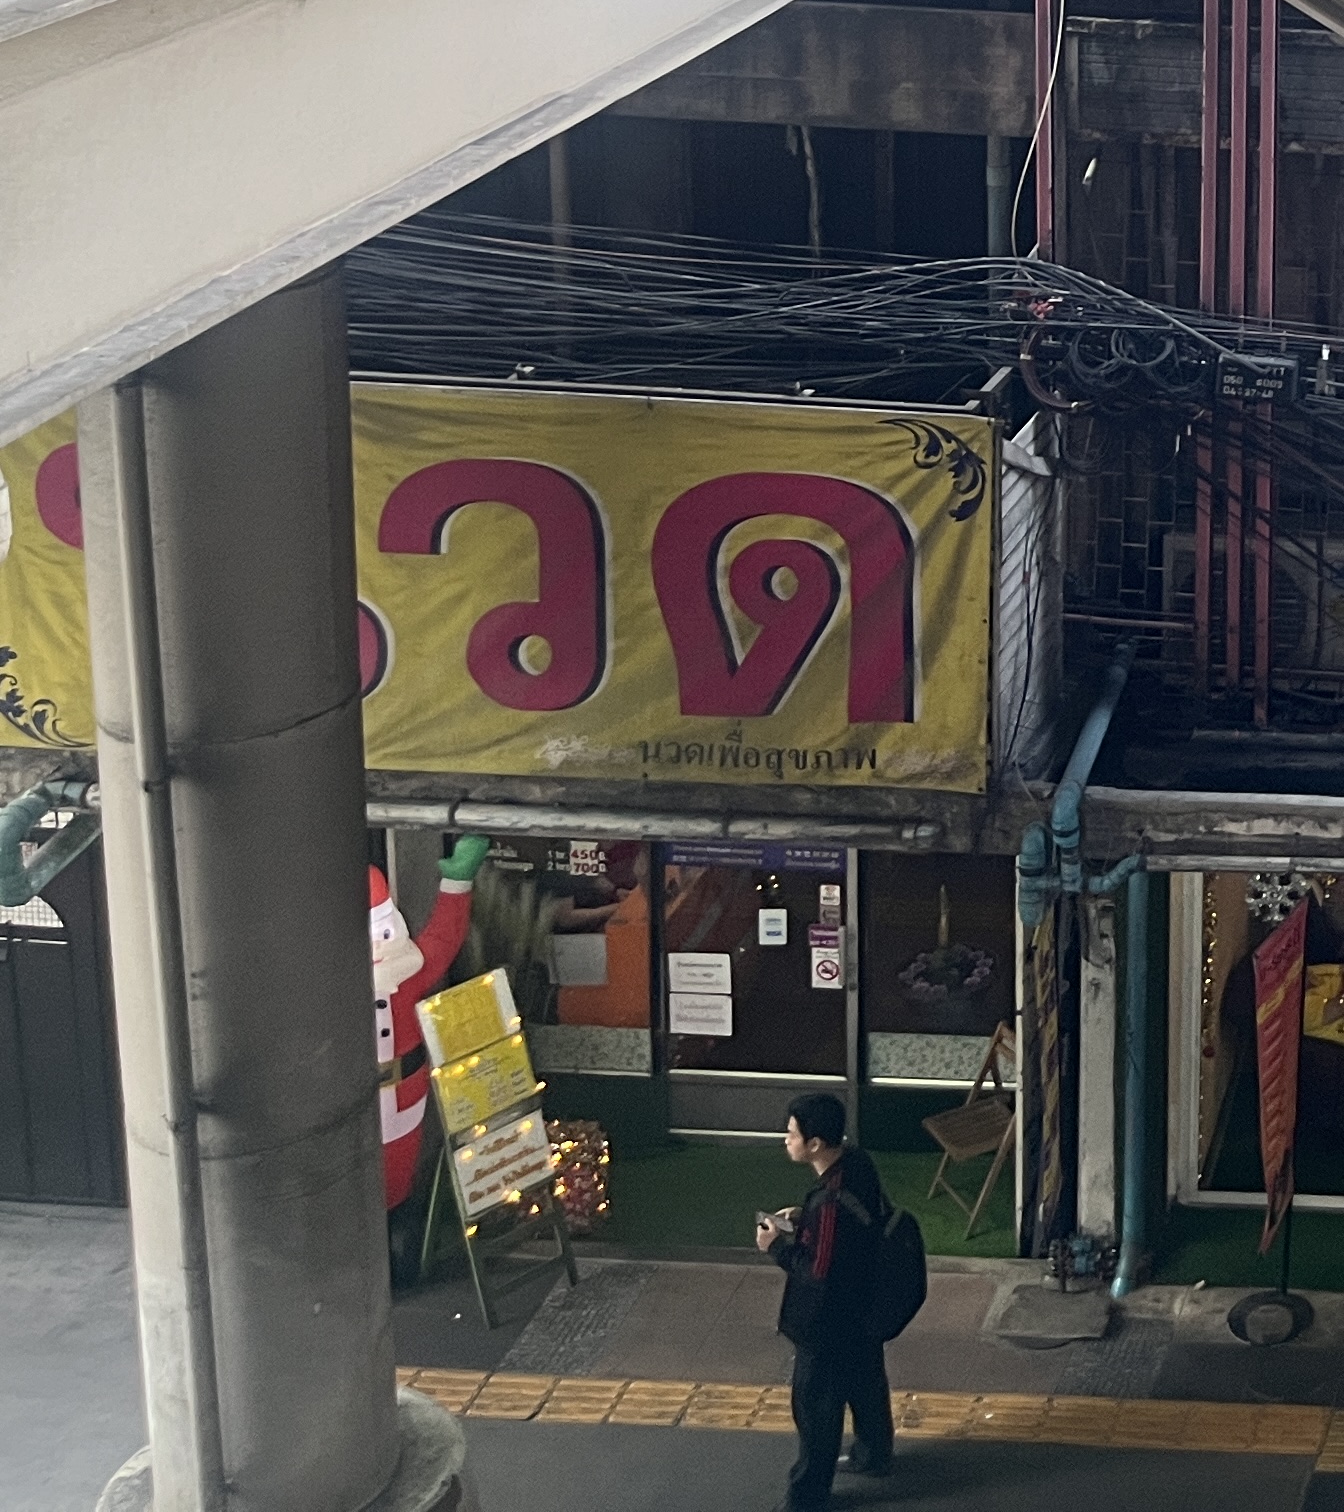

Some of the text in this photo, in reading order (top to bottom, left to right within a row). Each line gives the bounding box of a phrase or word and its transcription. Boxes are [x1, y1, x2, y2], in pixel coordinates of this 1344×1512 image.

[638, 721, 877, 779] นวดเพื่อสุขภาพ
